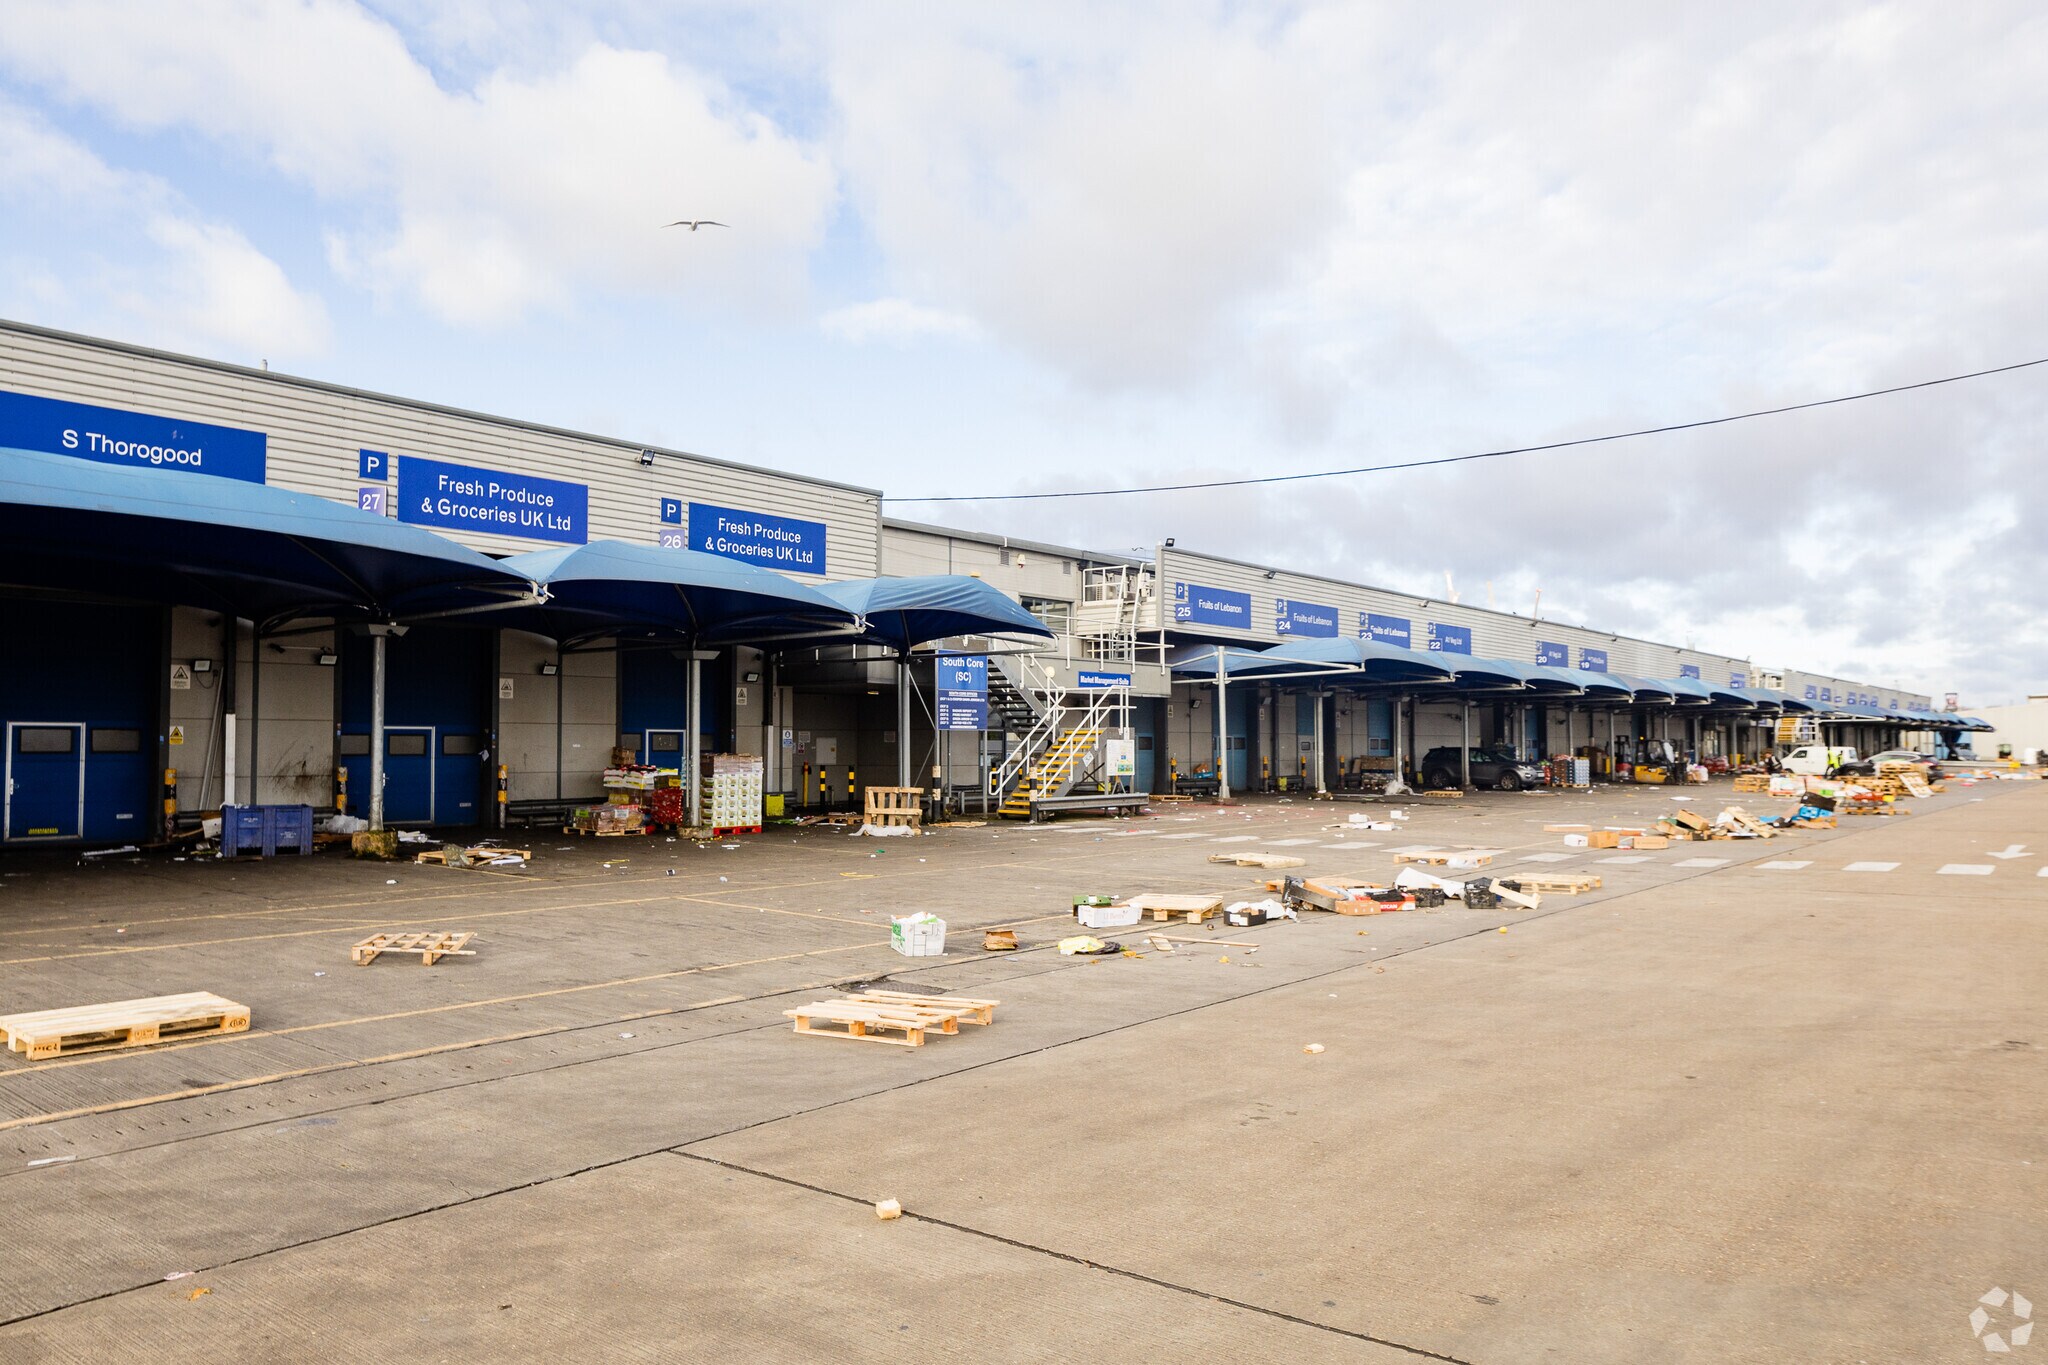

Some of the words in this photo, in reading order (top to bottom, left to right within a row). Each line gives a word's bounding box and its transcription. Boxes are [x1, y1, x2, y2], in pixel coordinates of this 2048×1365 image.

[62, 429, 79, 449] S
[85, 432, 202, 467] Thorogood
[367, 456, 380, 473] P
[438, 474, 484, 498] Fresh
[488, 482, 554, 508] Produce
[361, 494, 381, 511] 27
[421, 497, 434, 514] &
[437, 498, 517, 524] Groceries
[520, 510, 544, 528] UK
[547, 513, 571, 531] Ltd
[667, 504, 677, 518] P
[718, 517, 752, 536] Fresh
[754, 523, 802, 544] Produce
[663, 535, 682, 549] 26
[705, 537, 714, 551] &
[717, 537, 774, 558] Groceries
[776, 546, 793, 561] UK
[796, 548, 813, 564] Ltd
[1177, 586, 1184, 595] P
[1177, 607, 1191, 617] 25
[1198, 598, 1214, 610] Fruits
[1214, 601, 1220, 611] of
[1220, 602, 1242, 613] Lebanon
[1278, 621, 1291, 630] 24
[1293, 613, 1307, 623] Fruits
[1313, 616, 1333, 626] Lebanon
[1361, 632, 1373, 640] 23
[942, 657, 965, 667] South
[966, 658, 984, 668] Core
[955, 671, 972, 684] (SC)
